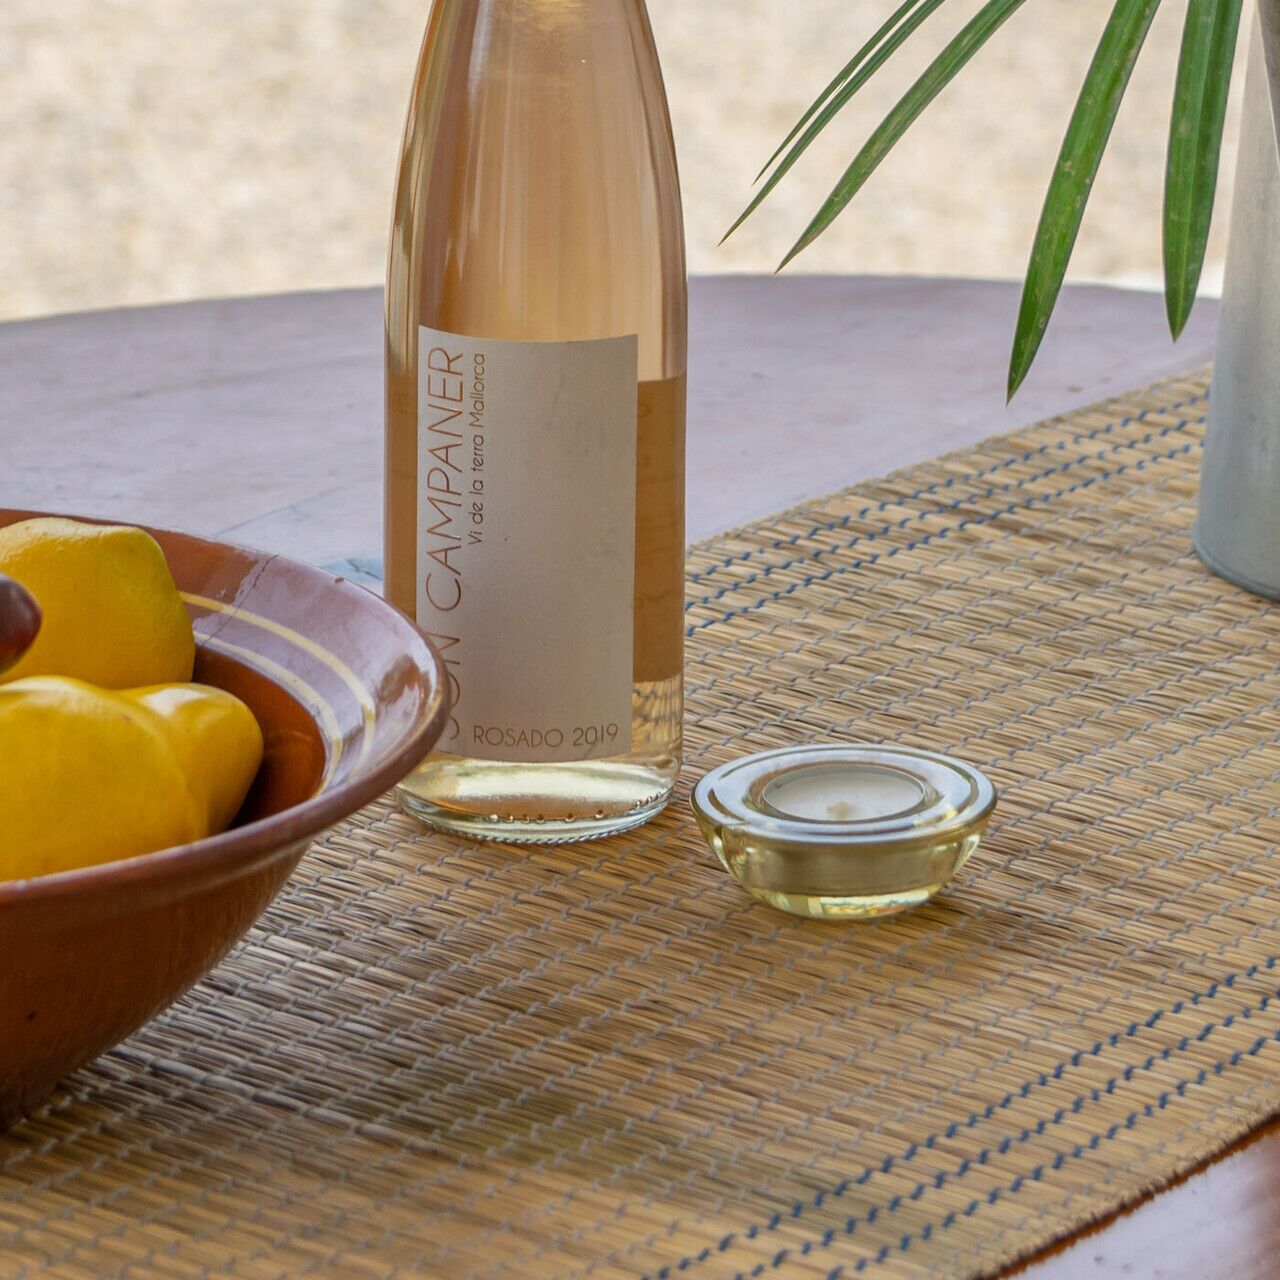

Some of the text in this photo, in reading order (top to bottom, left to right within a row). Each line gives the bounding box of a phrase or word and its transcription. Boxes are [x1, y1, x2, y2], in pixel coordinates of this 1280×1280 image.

[426, 347, 464, 612] CAMPANER
[467, 352, 485, 546] Vi de la terra Mallorca
[473, 722, 619, 748] ROSADO 2019
